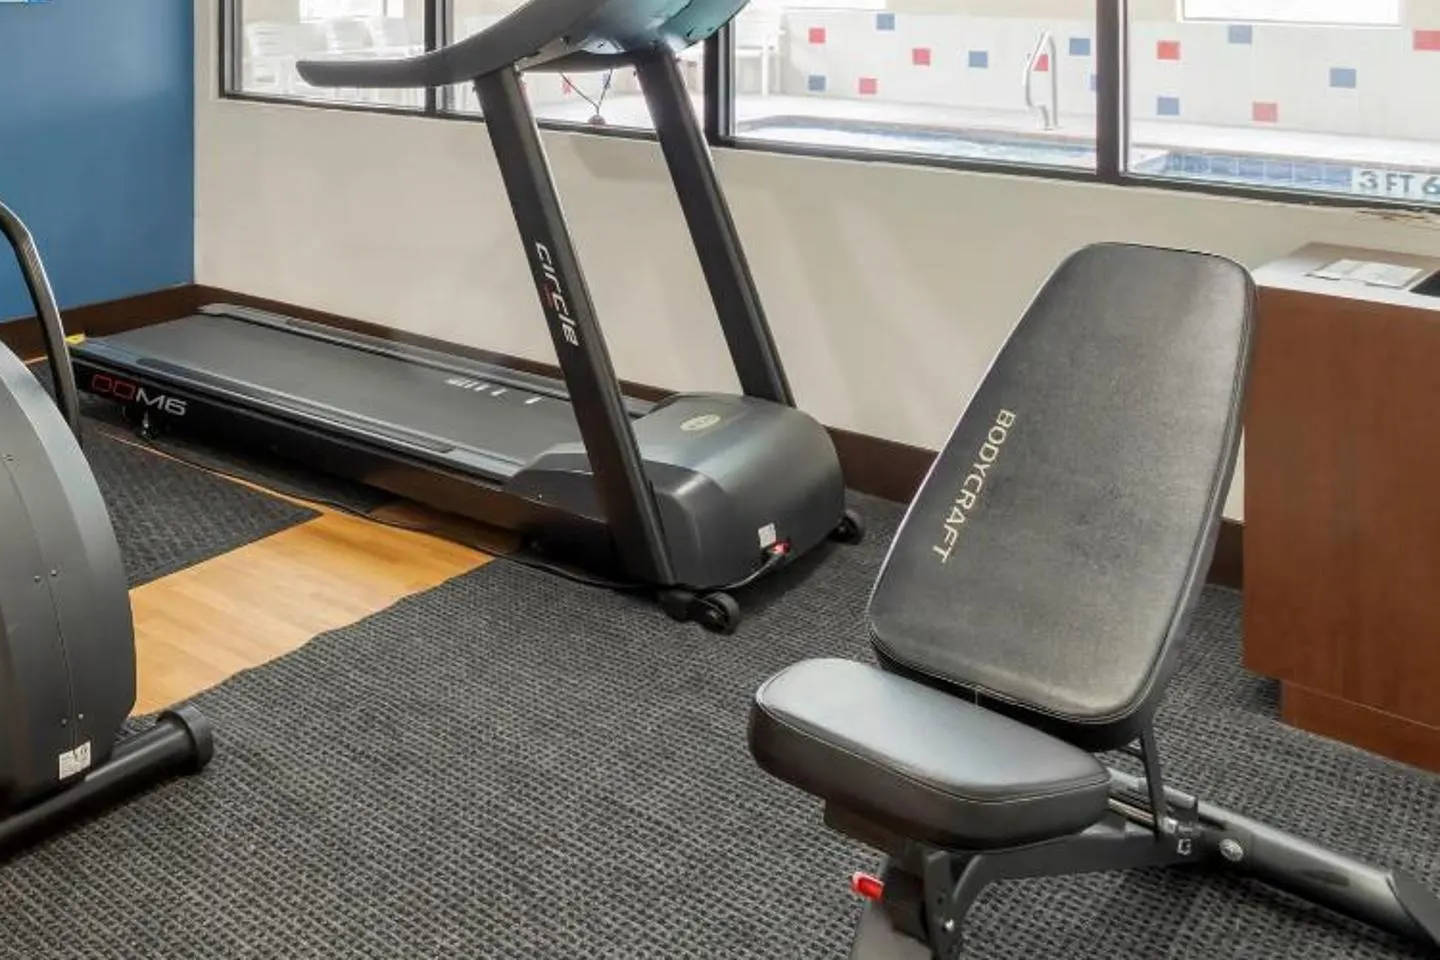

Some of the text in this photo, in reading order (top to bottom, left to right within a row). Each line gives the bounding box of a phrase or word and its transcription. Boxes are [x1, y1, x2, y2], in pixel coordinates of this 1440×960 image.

[1358, 170, 1440, 195] 3 FT 6
[931, 407, 1017, 564] BODYCRAFT
